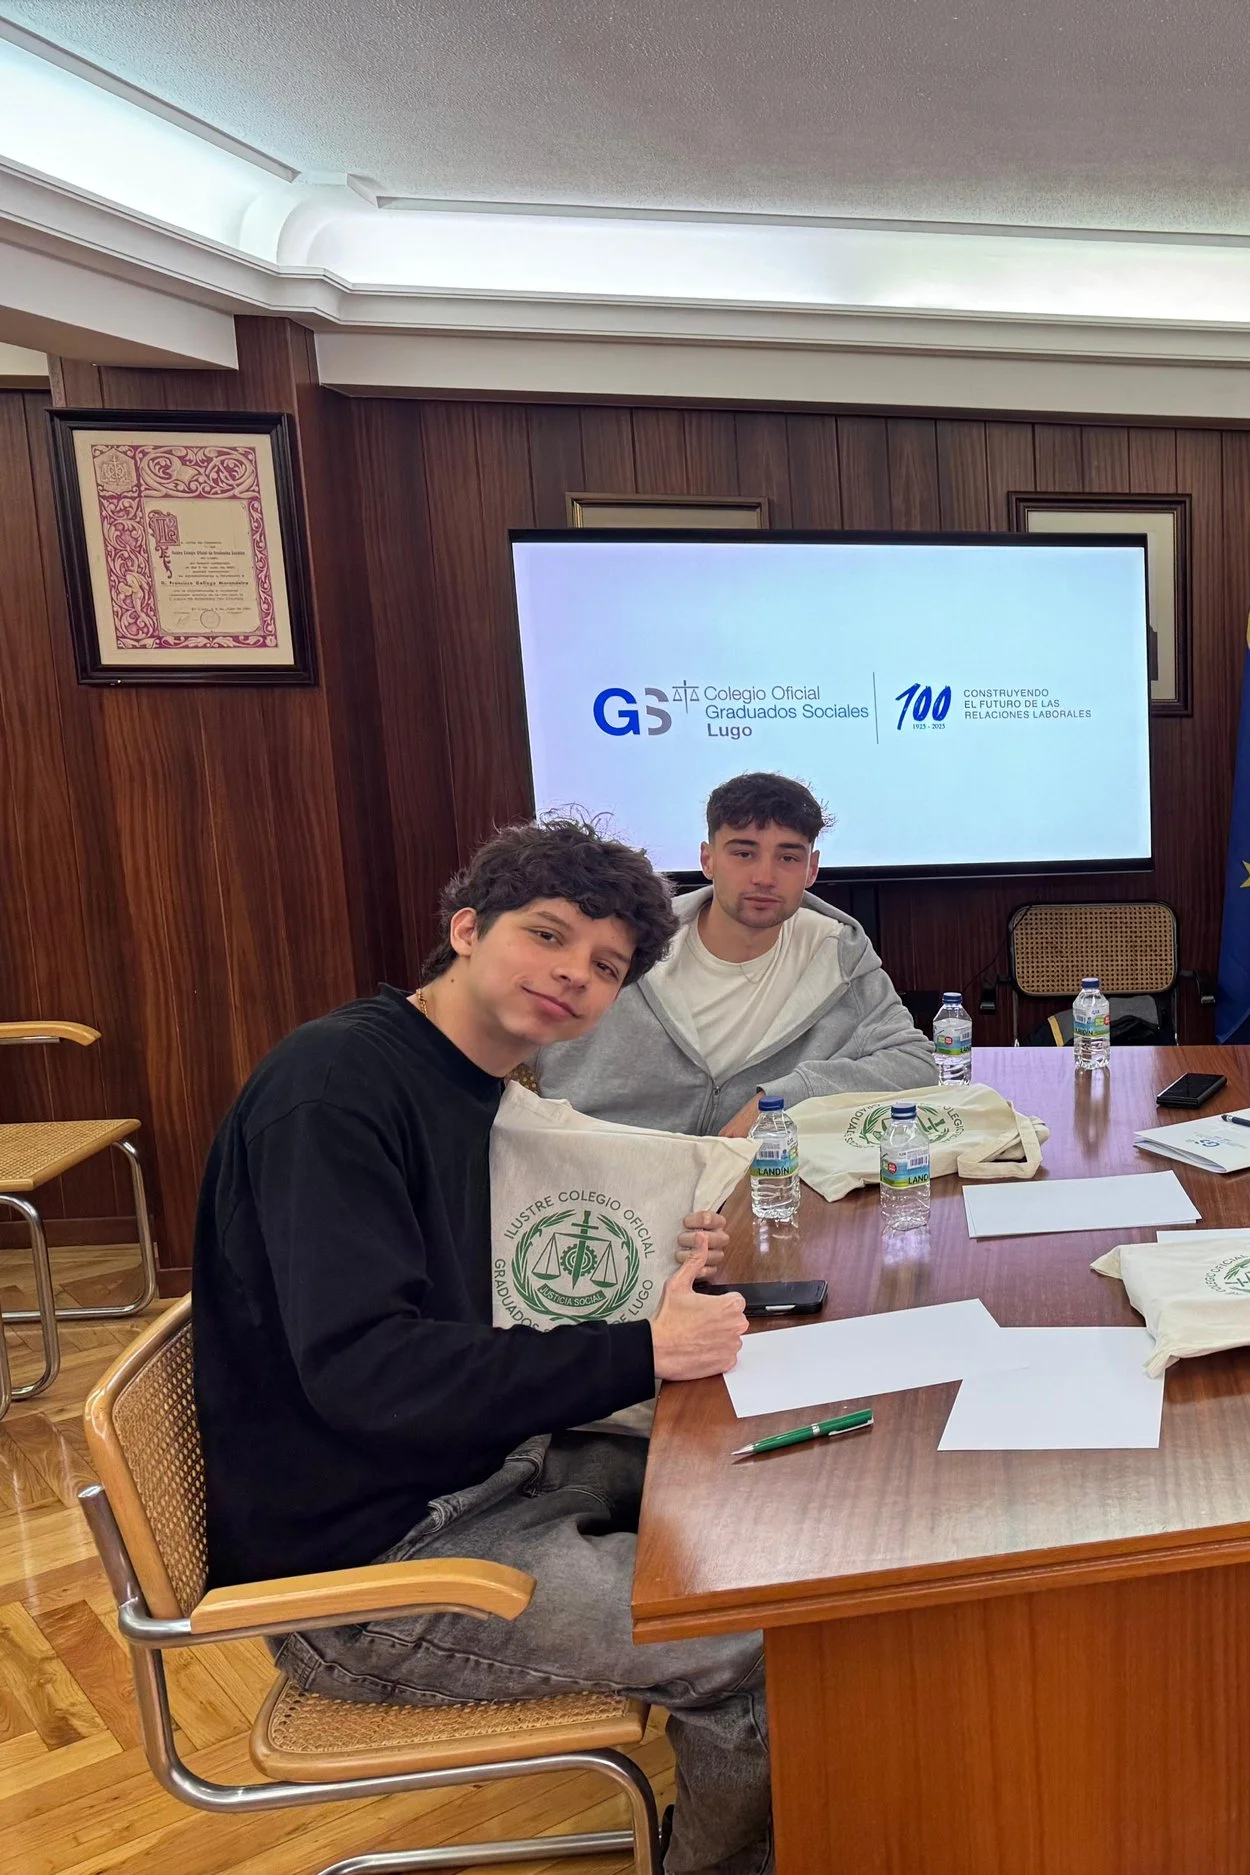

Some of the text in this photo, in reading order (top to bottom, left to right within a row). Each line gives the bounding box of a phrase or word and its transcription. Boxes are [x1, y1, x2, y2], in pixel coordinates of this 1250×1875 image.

[704, 686, 820, 704] Colegio Oficial
[964, 688, 1049, 698] CONSTRUYENDO
[593, 688, 672, 736] GS
[706, 704, 868, 719] Graduados Sociales
[895, 683, 951, 730] 100
[964, 700, 976, 708] EL
[1042, 700, 1060, 708] LAS
[964, 710, 1092, 719] RELACIONES LABORALES
[707, 723, 752, 740] Lugo
[758, 1164, 790, 1176] LANDÍN
[908, 1174, 929, 1184] LAND
[504, 1190, 655, 1259] ILUSTRE COLEGIO OFICIAL
[539, 1287, 603, 1306] JUSTICIA SOCIAL
[628, 1279, 654, 1316] LUGO
